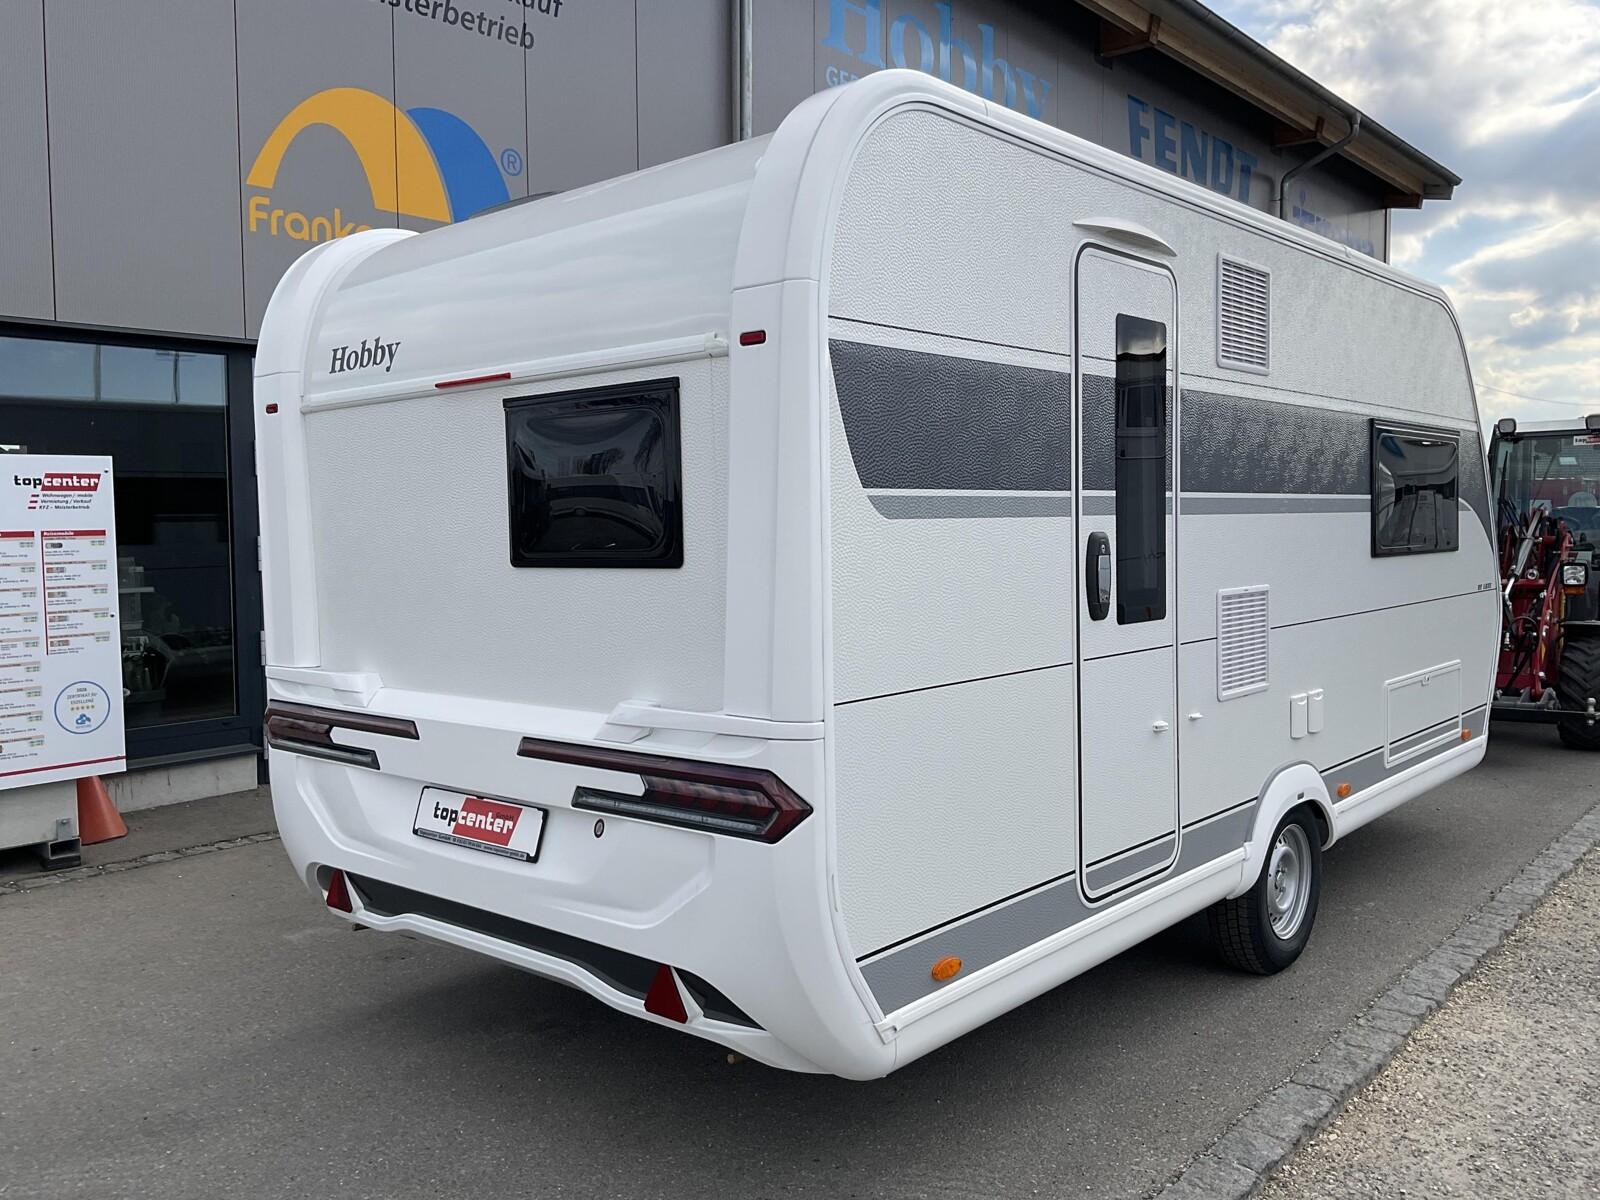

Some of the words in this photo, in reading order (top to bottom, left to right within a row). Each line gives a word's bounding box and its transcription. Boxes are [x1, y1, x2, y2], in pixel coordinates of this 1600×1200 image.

[382, 0, 534, 49] terbetrieb
[508, 0, 562, 17] auf
[1127, 94, 1259, 205] FENDT
[329, 336, 401, 374] Hobby
[14, 475, 99, 488] topcenter
[433, 801, 514, 834] topcenter
